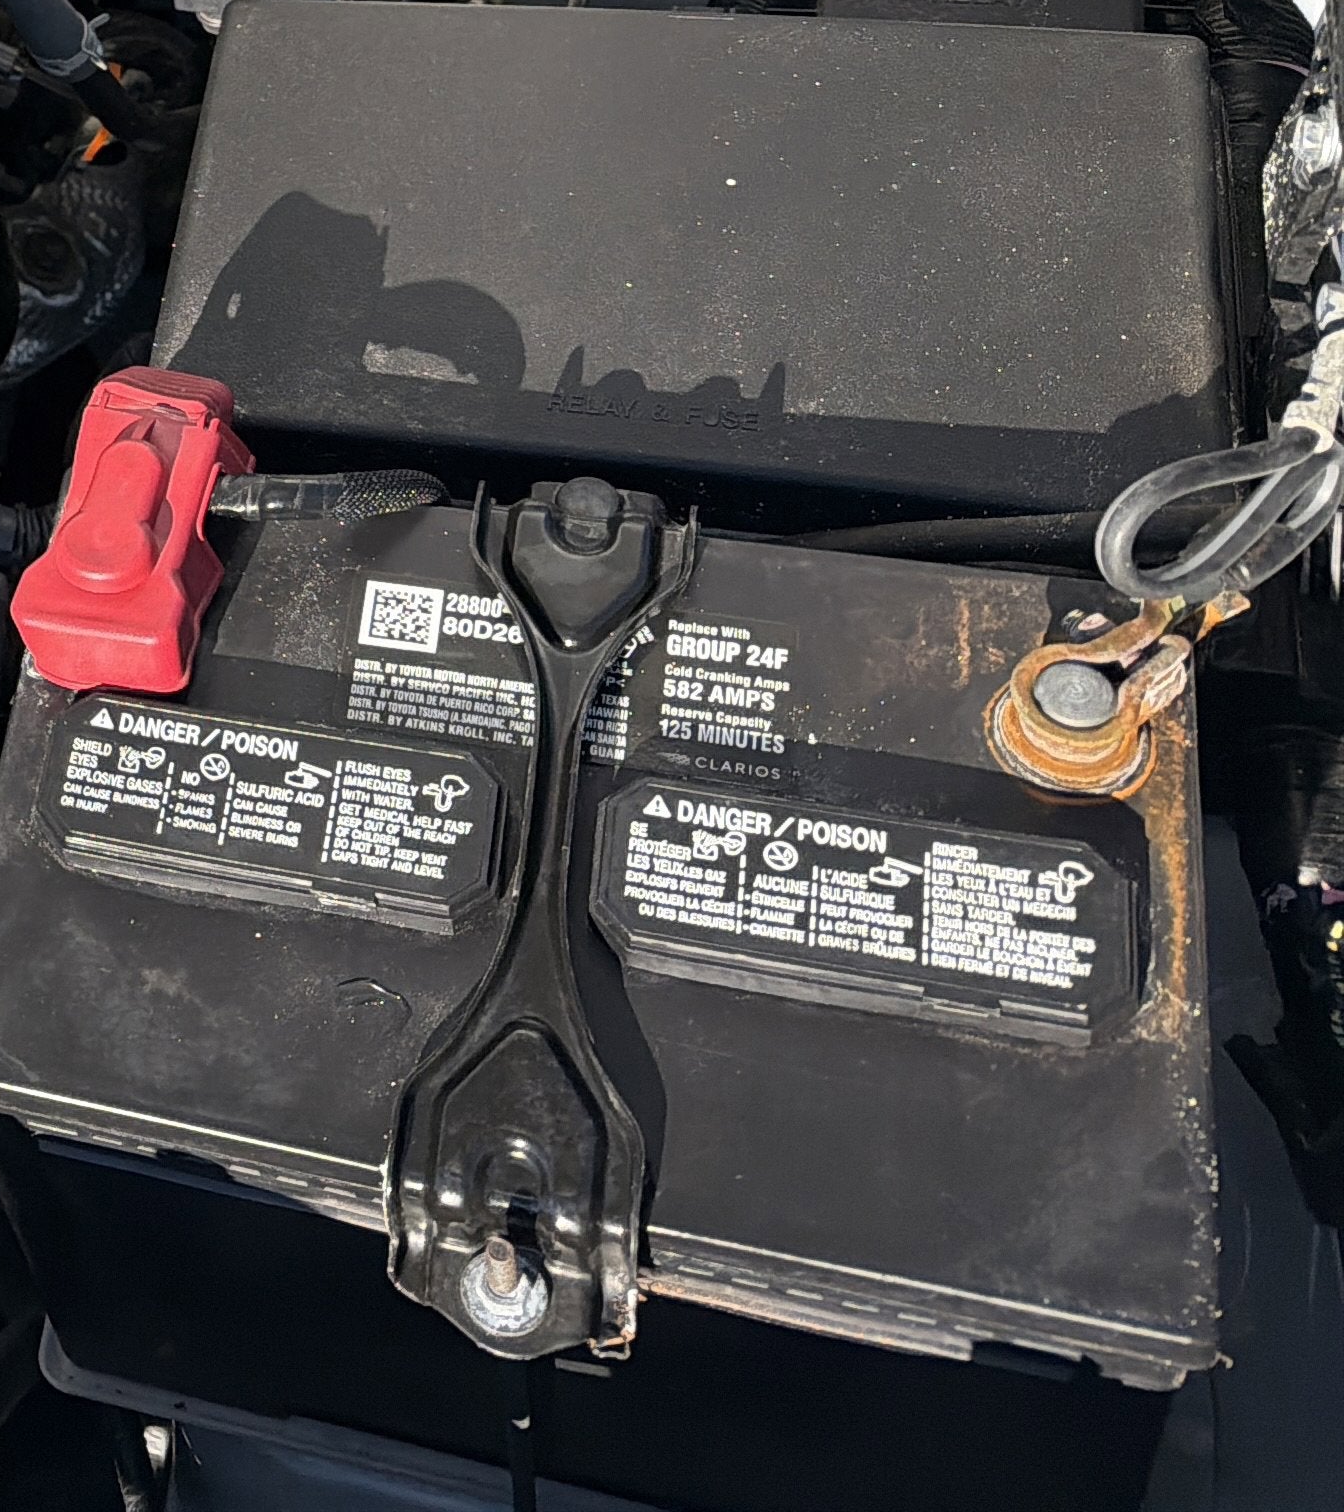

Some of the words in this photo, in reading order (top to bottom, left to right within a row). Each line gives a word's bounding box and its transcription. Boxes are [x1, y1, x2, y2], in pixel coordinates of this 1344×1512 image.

[547, 393, 636, 419] RELAY
[650, 403, 670, 422] &
[685, 407, 760, 432] FUSE
[668, 619, 718, 636] Replace
[721, 626, 750, 640] With
[667, 634, 740, 662] GROUP
[746, 645, 788, 669] 24F
[354, 658, 383, 672] DISTR.
[385, 663, 398, 674] BY
[399, 664, 432, 679] TOYOTA
[433, 669, 466, 684] MOTOR
[467, 675, 498, 689] NORTH
[665, 663, 692, 678] Cold
[695, 668, 751, 688] Cranking
[754, 676, 790, 692] Amps
[353, 671, 386, 685] DISTR.
[391, 676, 405, 687] BY
[452, 685, 493, 701] PACIFIC
[663, 678, 703, 701] 582
[708, 685, 777, 711] AMPS
[349, 696, 373, 709] DISTR.
[375, 700, 386, 710] BY
[388, 702, 416, 715] TOYOTA
[419, 706, 449, 720] TSUSHO
[350, 683, 377, 697] DISTR.
[380, 688, 391, 698] BY
[393, 690, 424, 704] TOYOTA
[426, 694, 437, 706] DE
[439, 696, 472, 711] PUERTO
[474, 702, 494, 714] RICO
[601, 694, 630, 708] TEXAS
[347, 709, 384, 723] DISTR.
[388, 715, 403, 726] BY
[405, 718, 445, 733] ATKINS
[493, 731, 516, 744] INC.
[605, 721, 628, 735] RICO
[661, 703, 712, 721] Reserve
[716, 711, 772, 731] Capacity
[72, 737, 112, 756] SHIELD
[118, 713, 200, 745] DANGER
[221, 730, 298, 761] POISON
[659, 718, 692, 739] 125
[698, 723, 784, 753] MINUTES
[69, 751, 98, 768] EYES
[590, 744, 626, 761] GUAM
[181, 771, 200, 786] NO
[345, 760, 381, 776] FLUSH
[382, 766, 411, 782] EYES
[695, 756, 780, 779] CLARIOS
[66, 766, 125, 788] EXPLOSIVE
[126, 777, 163, 795] GASES
[343, 775, 419, 796] IMMEDIATELY
[60, 795, 75, 807] OR
[75, 799, 108, 813] INJURY
[63, 781, 82, 794] CAN
[83, 785, 112, 801] CAUSE
[112, 791, 160, 809] BLINDNESS
[178, 789, 215, 805] SPARKS
[236, 781, 294, 802] SULFURIC
[294, 791, 324, 807] ACID
[342, 788, 370, 803] WITH
[174, 802, 212, 819] FLAMES
[233, 798, 254, 811] CAN
[255, 802, 288, 817] CAUSE
[338, 802, 362, 816] GET
[363, 806, 410, 826] MEDICAL
[412, 815, 442, 829] HELP
[443, 819, 472, 834] FAST
[173, 816, 216, 833] SMOKING
[231, 812, 284, 830] BLINDNESS
[285, 821, 301, 833] OR
[337, 815, 361, 830] KEEP
[363, 819, 385, 833] OUT
[386, 823, 401, 834] OF
[403, 825, 422, 839] THE
[423, 830, 456, 844] REACH
[629, 821, 648, 837] SE
[677, 800, 772, 836] DANGER
[797, 818, 887, 853] POISON
[228, 826, 264, 841] SEVERE
[265, 832, 298, 847] BURNS
[335, 826, 350, 839] OF
[351, 829, 400, 847] CHILDREN
[333, 837, 349, 849] DO
[350, 840, 372, 853] NOT
[393, 848, 419, 861] KEEP
[421, 852, 448, 866] VENT
[628, 837, 691, 861] PROTÉGER
[932, 842, 978, 861] RINCER
[331, 849, 358, 864] CAPS
[361, 853, 390, 868] TIGHT
[391, 860, 412, 873] AND
[413, 864, 444, 879] LEVEL
[627, 853, 650, 870] LES
[704, 869, 726, 883] GAZ
[625, 870, 678, 890] EXPLOSIFS
[753, 874, 809, 896] AUCUNE
[930, 872, 954, 886] LES
[956, 875, 986, 891] YEUX
[1035, 887, 1051, 902] ET
[685, 897, 700, 910] LA
[820, 884, 895, 910] SULFURIQUE
[931, 885, 1000, 908] CONSULTER
[1002, 897, 1020, 913] UN
[638, 903, 654, 916] OU
[656, 906, 677, 921] DES
[749, 907, 795, 925] FLAMME
[820, 902, 848, 918] PEUT
[931, 899, 964, 918] SANS
[818, 918, 833, 931] LA
[870, 927, 887, 942] OU
[886, 930, 904, 944] DE
